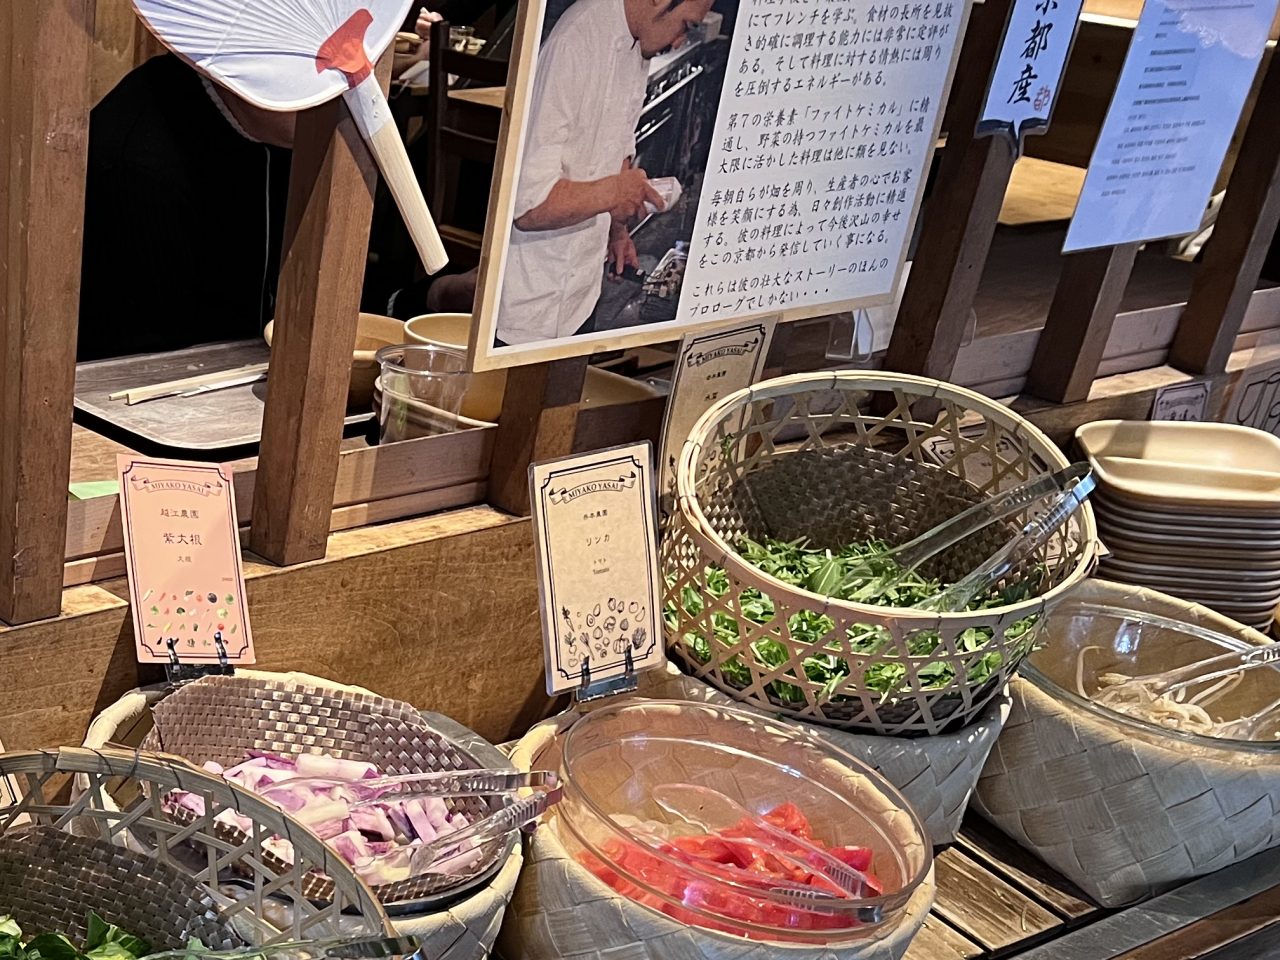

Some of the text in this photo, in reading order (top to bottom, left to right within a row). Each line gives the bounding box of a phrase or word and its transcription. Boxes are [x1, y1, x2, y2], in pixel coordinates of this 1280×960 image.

[151, 481, 206, 494] MIYAKO YASAI
[568, 482, 619, 498] MIYAKO YASAI
[162, 532, 203, 546] 紫大根
